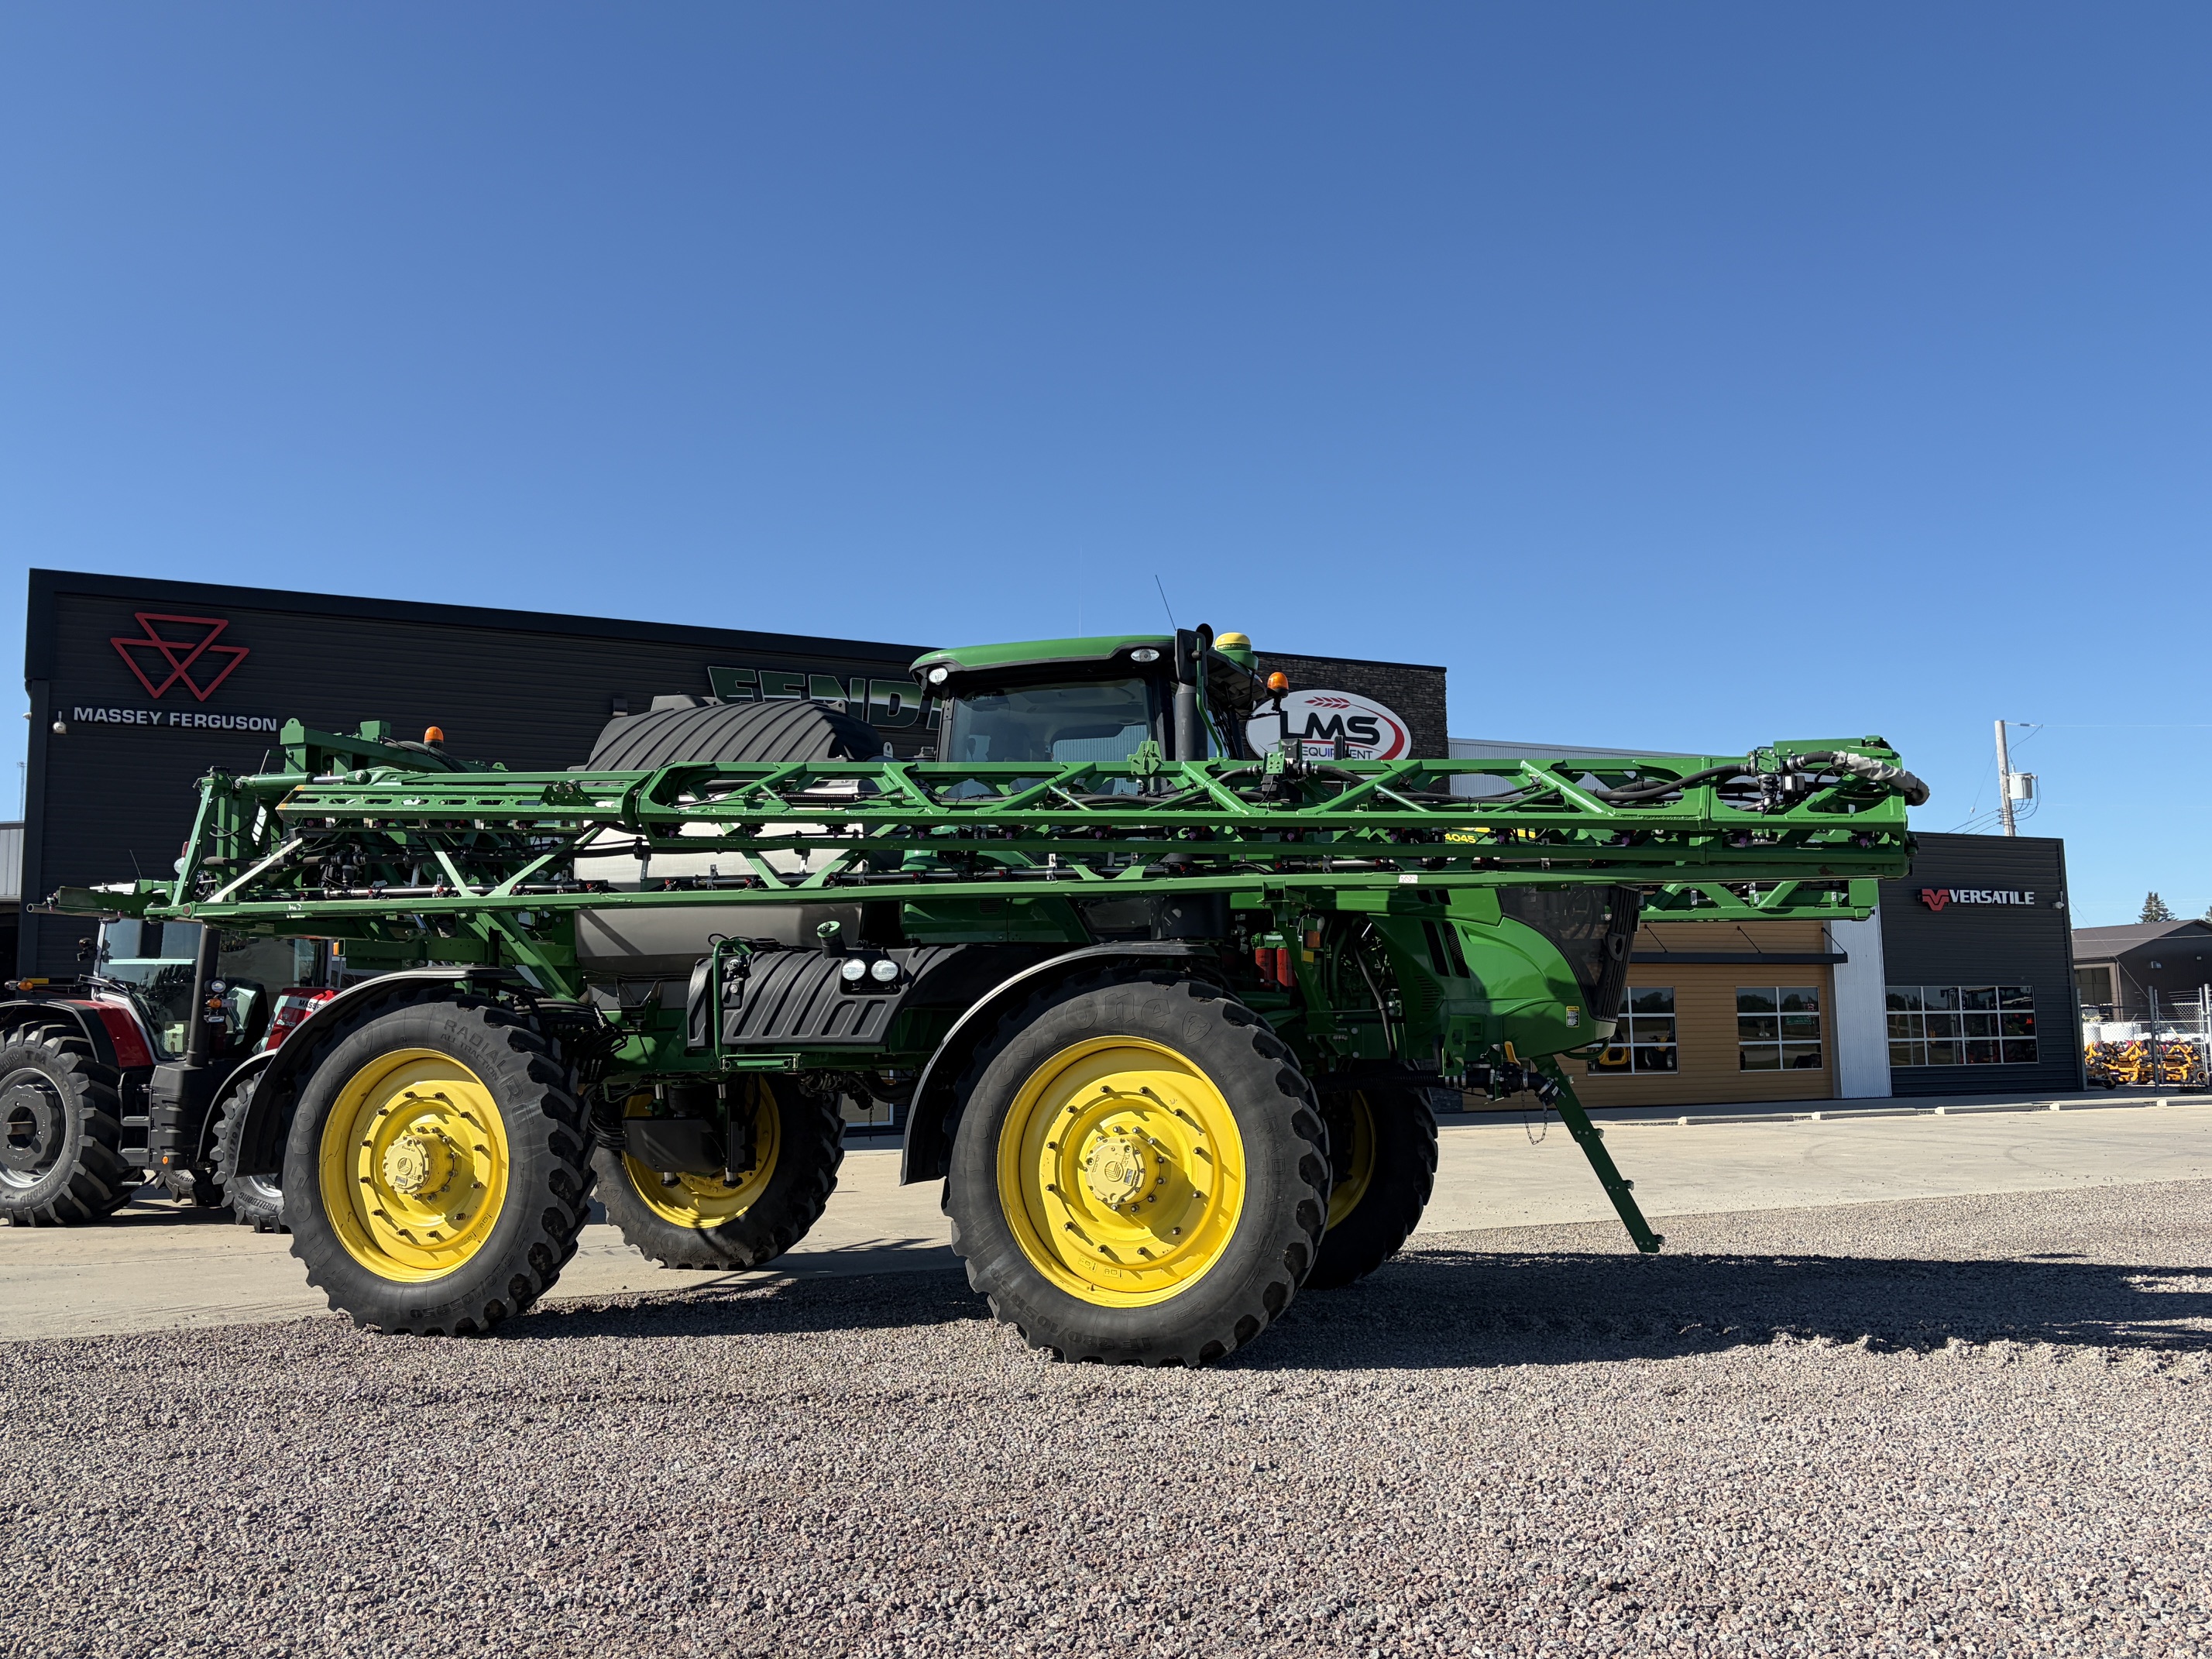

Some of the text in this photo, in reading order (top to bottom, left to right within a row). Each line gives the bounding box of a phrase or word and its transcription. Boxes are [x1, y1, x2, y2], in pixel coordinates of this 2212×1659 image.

[74, 706, 277, 731] MASSEY FERGUSON
[707, 666, 943, 730] FEND
[1279, 710, 1380, 745] LMS
[1301, 746, 1373, 760] EQUIENT
[1949, 889, 2035, 905] VERSATILE
[441, 1034, 500, 1081] ALL TRACTION
[444, 1019, 507, 1074] RADIAL
[1262, 1115, 1286, 1221] RADIAL
[239, 1191, 278, 1213] TRELLEBORG
[991, 1267, 1115, 1350] 380/105R50
